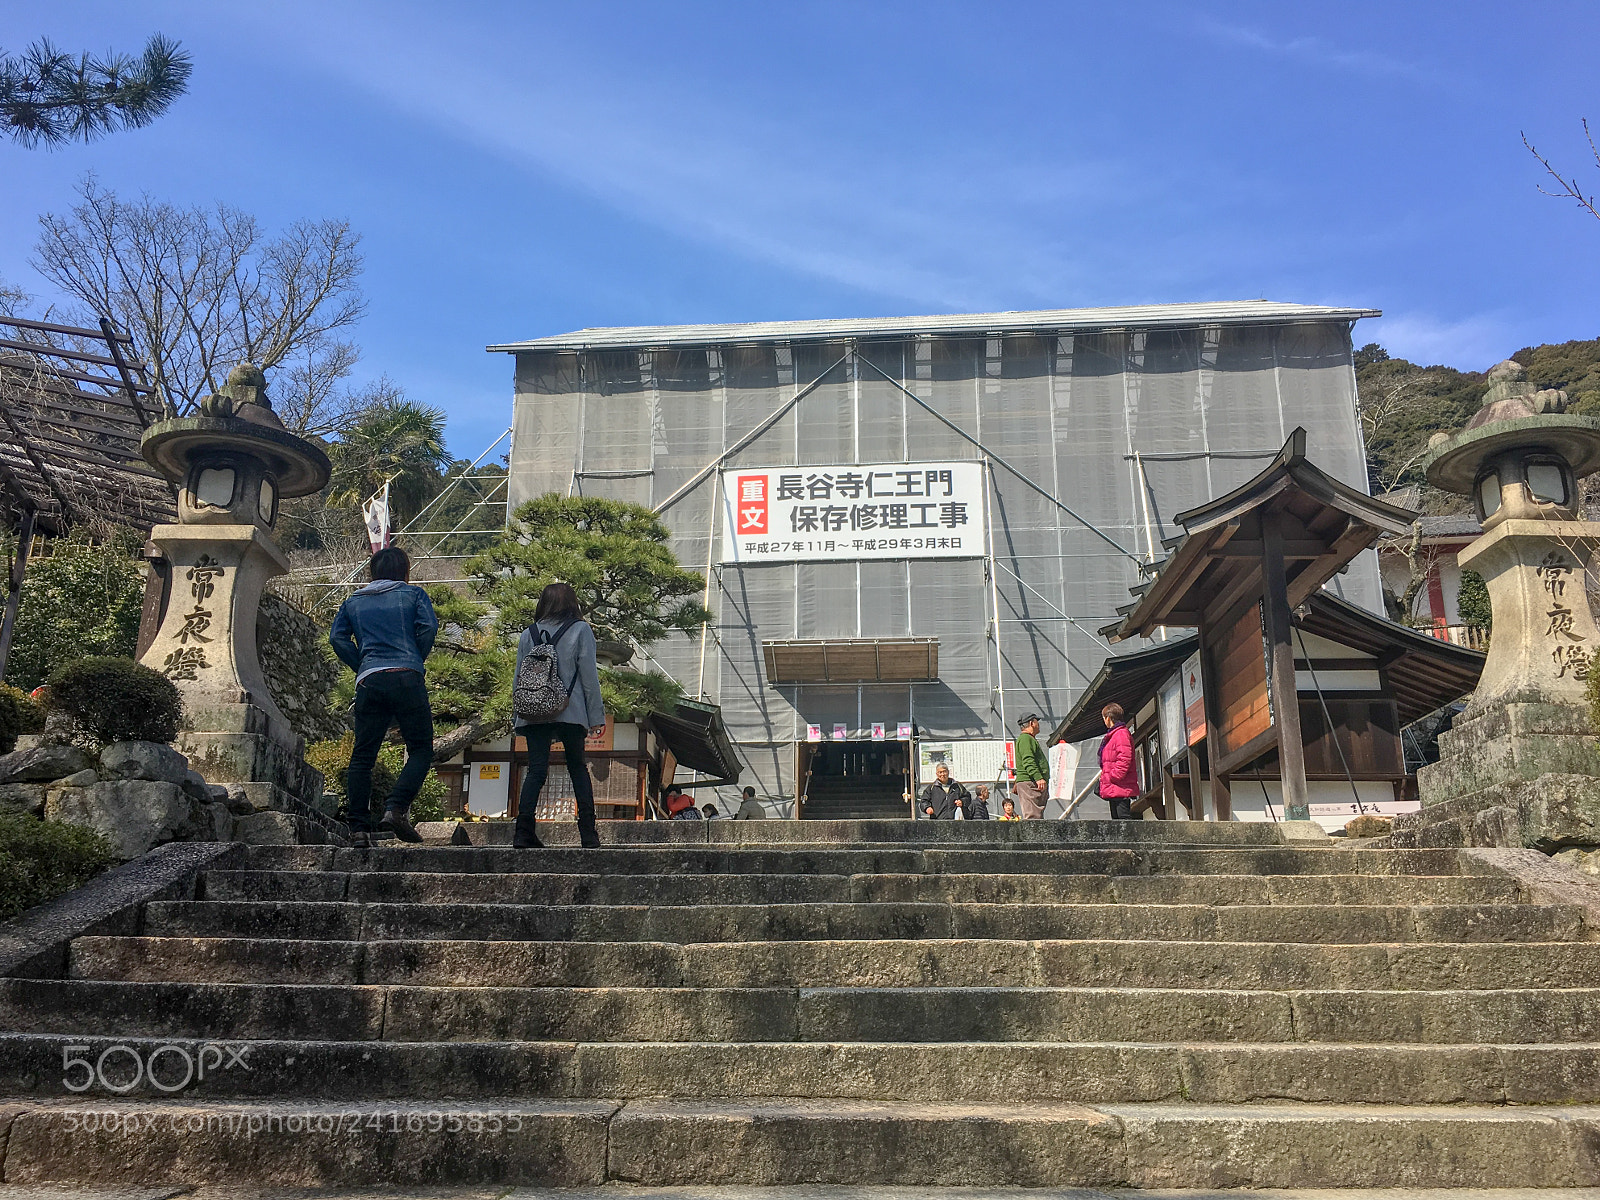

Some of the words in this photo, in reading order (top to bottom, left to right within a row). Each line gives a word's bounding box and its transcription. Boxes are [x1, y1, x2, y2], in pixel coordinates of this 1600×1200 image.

[777, 469, 953, 501] 長谷寺仁王門
[741, 480, 765, 529] 重文
[789, 501, 969, 533] 保存修理工事
